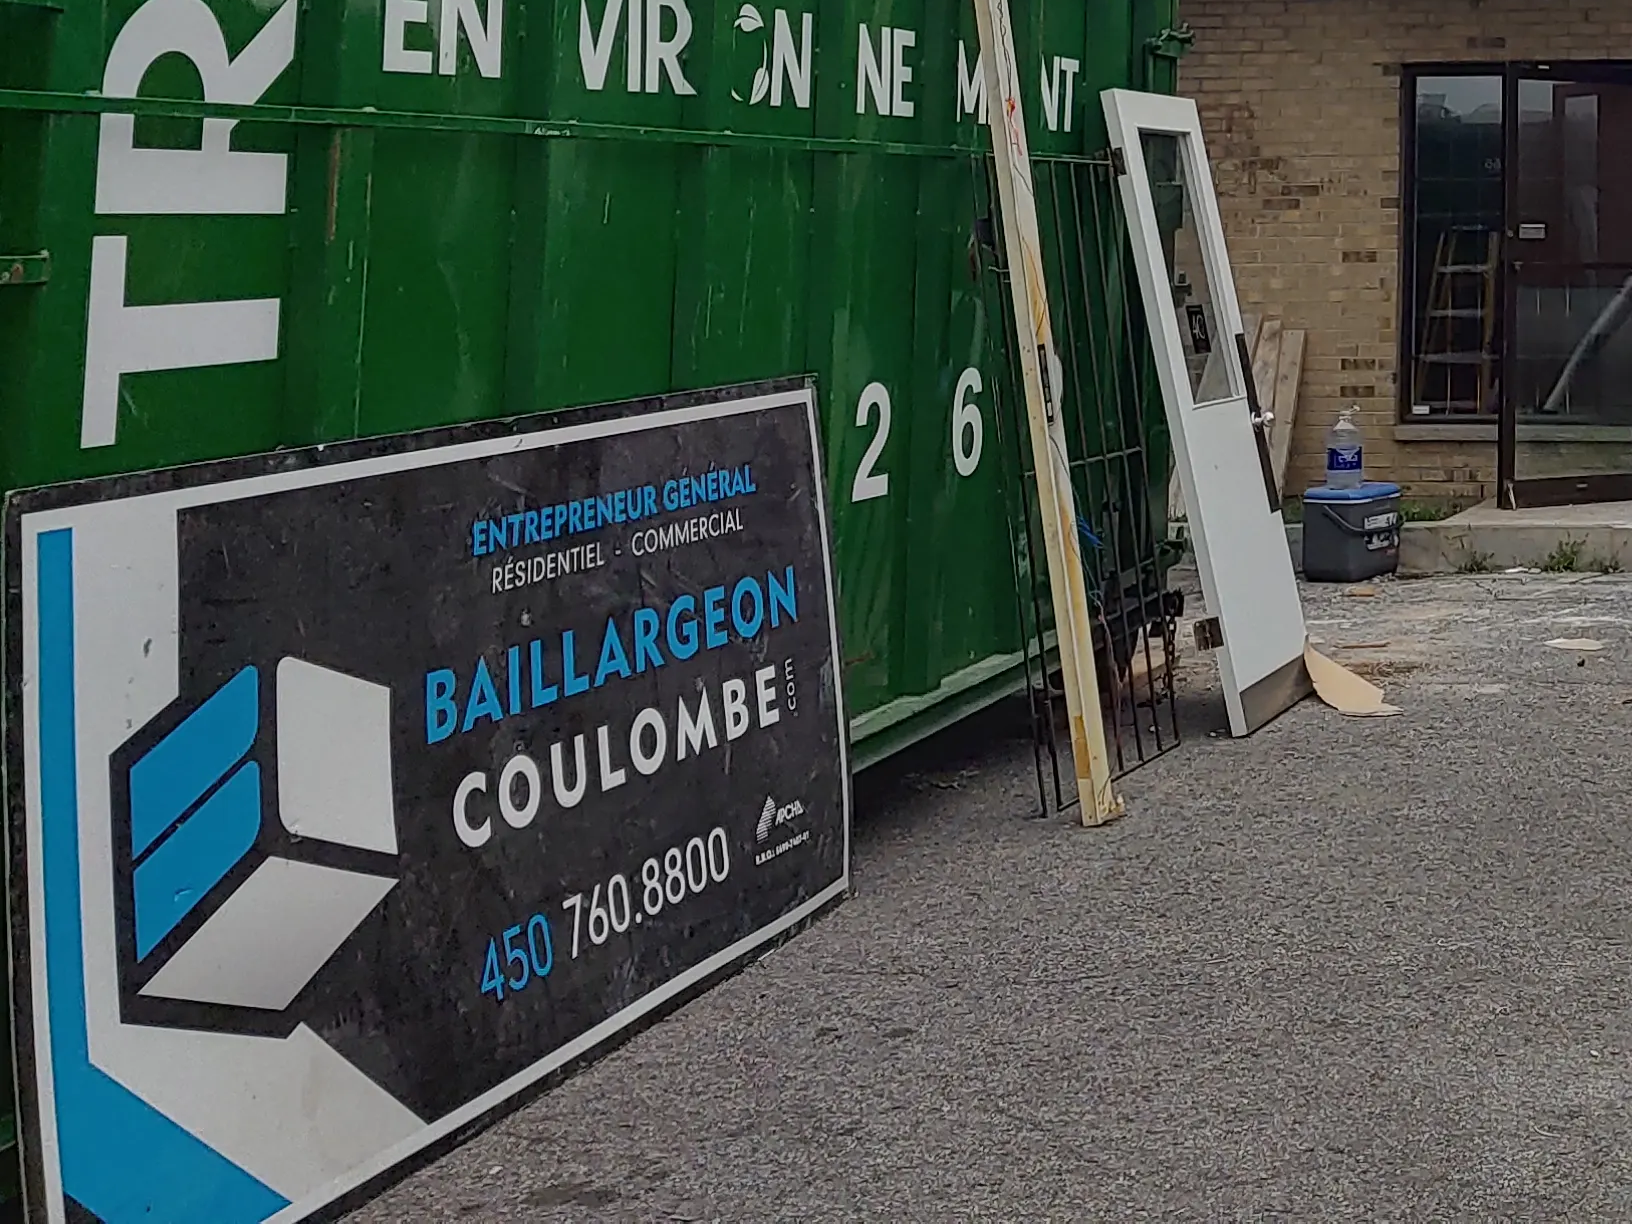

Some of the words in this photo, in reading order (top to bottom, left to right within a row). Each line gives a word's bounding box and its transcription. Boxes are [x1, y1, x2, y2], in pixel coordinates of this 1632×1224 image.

[471, 485, 658, 557] ENTREPRENEUR
[662, 462, 757, 513] GÉNÉRAL
[491, 541, 605, 594] RÉSIDENTIEL
[631, 508, 744, 557] COMMERCIAL
[425, 564, 799, 745] BAILLARGEON
[452, 664, 781, 849] COULOMBE
[480, 912, 553, 1001] 450
[562, 826, 731, 960] 760.8800
